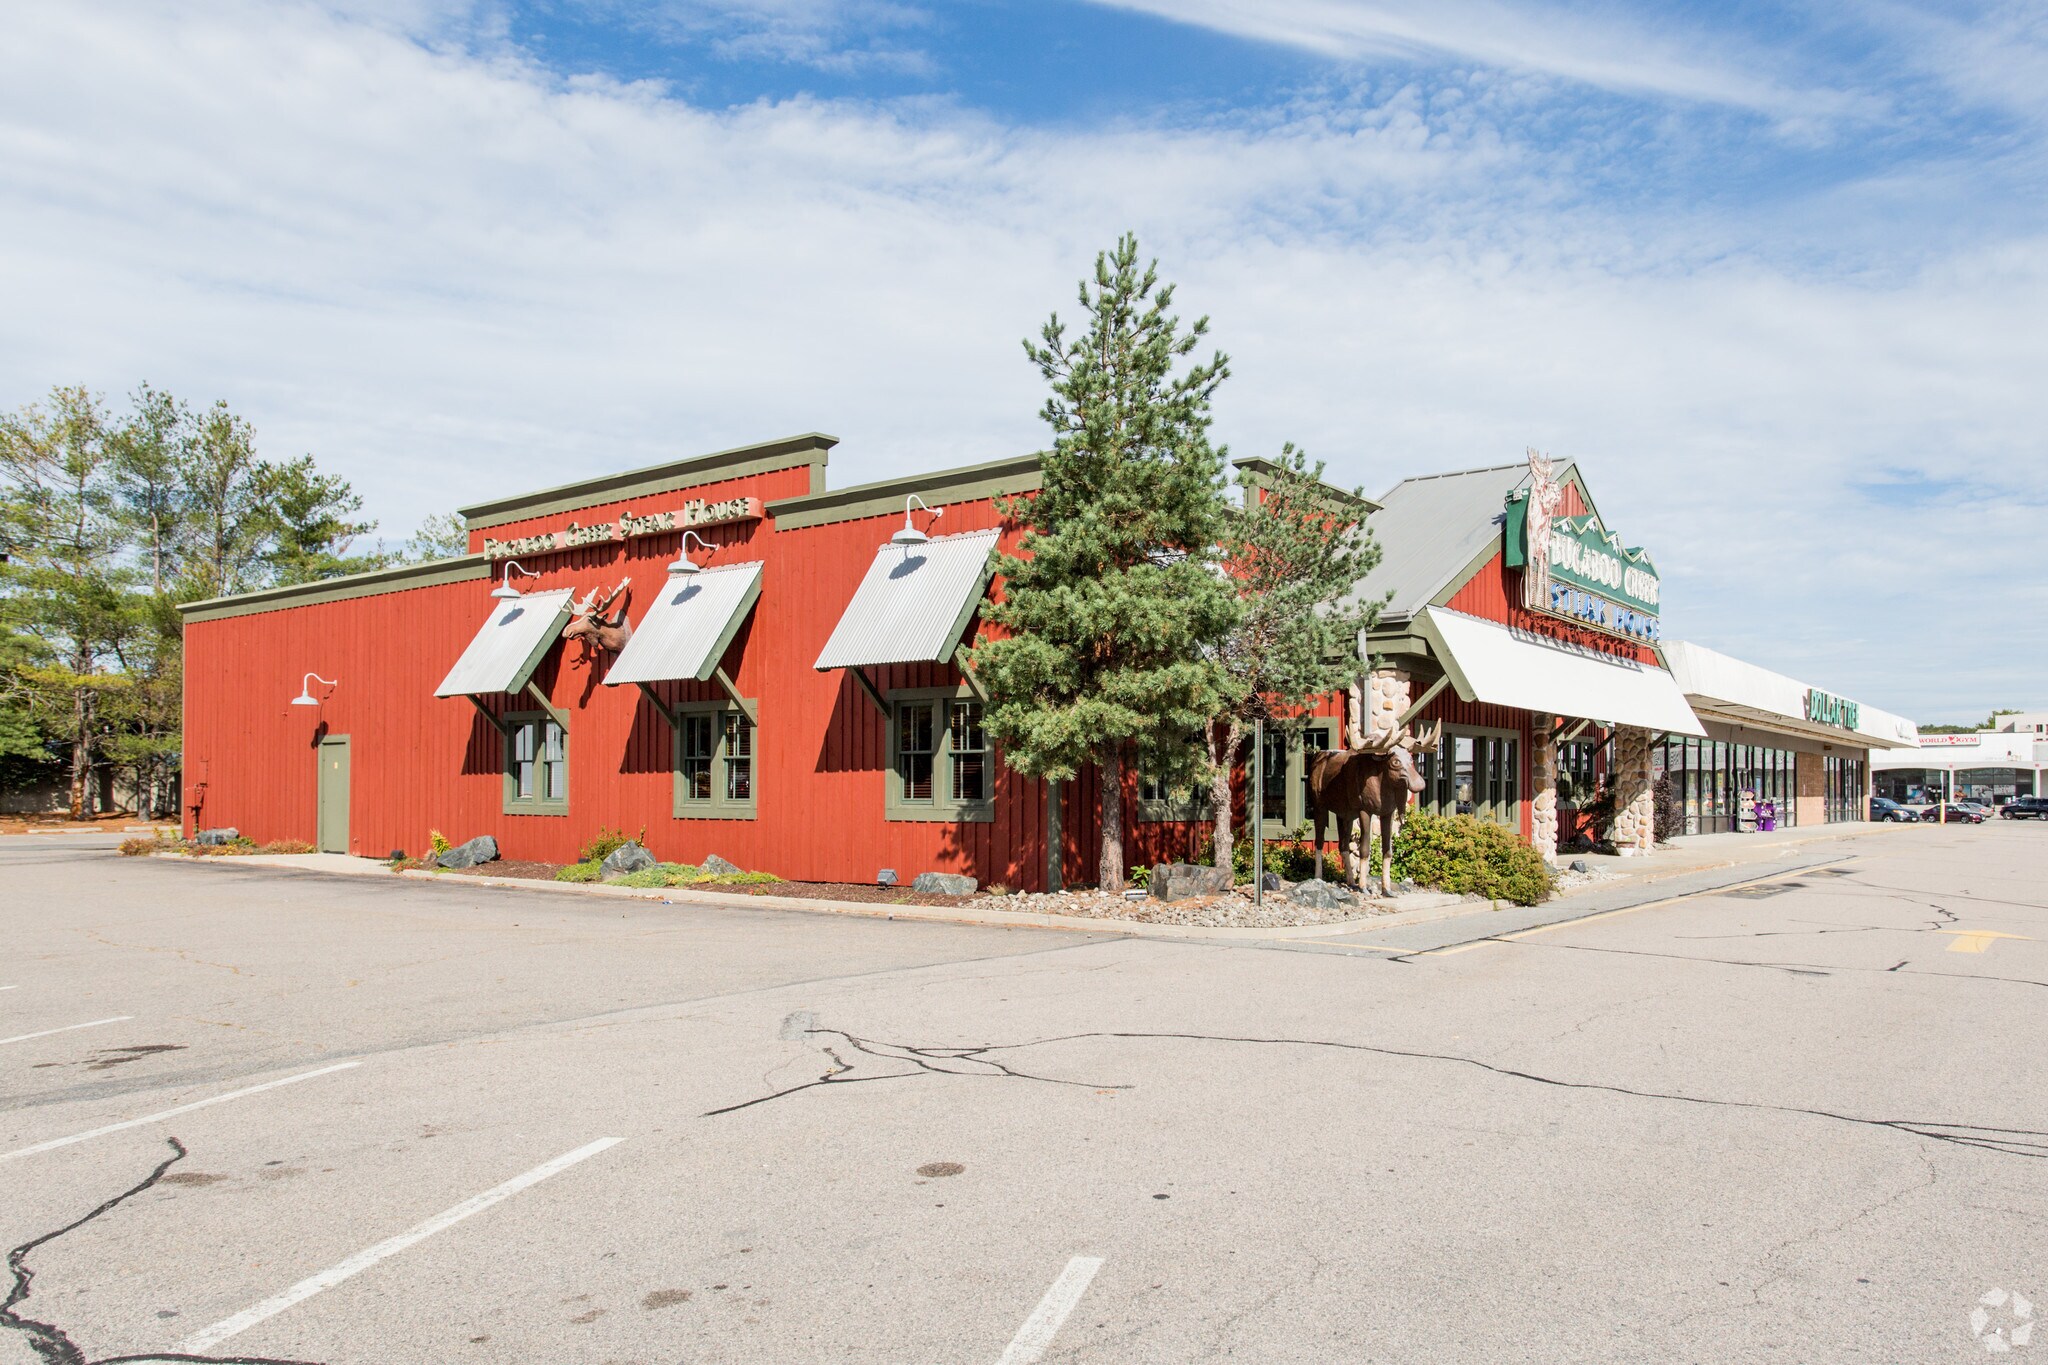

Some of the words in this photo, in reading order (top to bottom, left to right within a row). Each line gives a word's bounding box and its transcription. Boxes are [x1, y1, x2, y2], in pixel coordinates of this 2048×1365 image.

[564, 522, 613, 547] CREEK
[619, 511, 676, 538] STEAK
[684, 497, 750, 526] HOUSE
[1550, 531, 1622, 590] BUGABOO
[1624, 565, 1660, 606] CREEK
[1551, 583, 1606, 624] STEAK
[1612, 605, 1660, 642] HOUSE
[1809, 688, 1841, 725] DOLLAR
[1842, 699, 1860, 730] TREE
